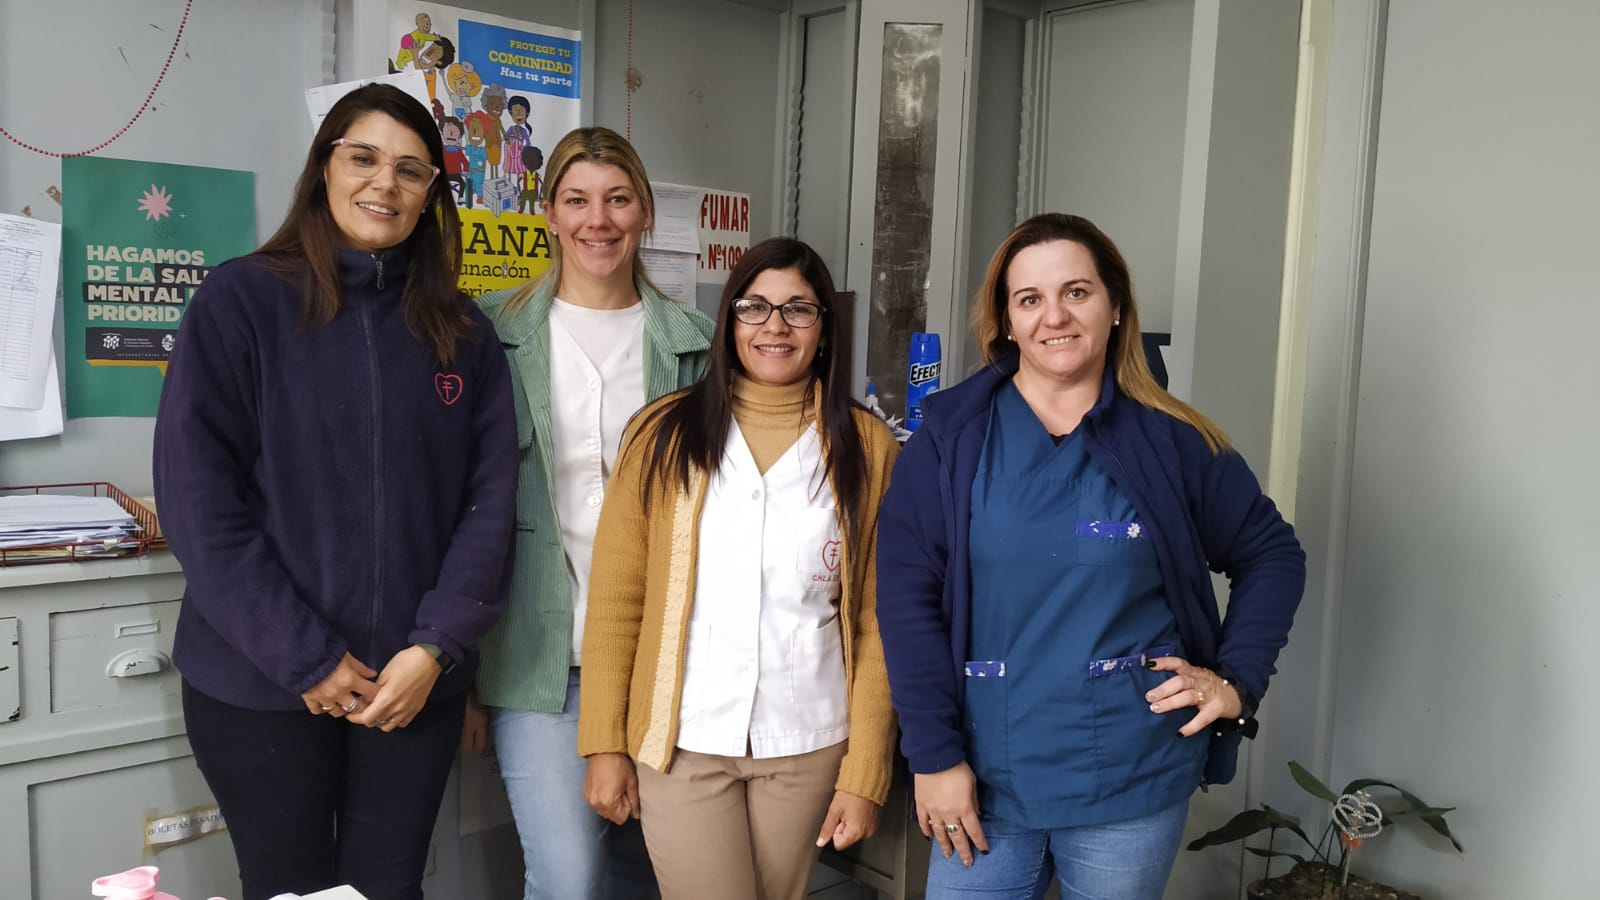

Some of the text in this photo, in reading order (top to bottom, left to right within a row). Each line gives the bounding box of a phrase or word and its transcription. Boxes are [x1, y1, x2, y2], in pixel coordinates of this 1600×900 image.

[510, 40, 571, 57] PROTEGE TU
[488, 50, 573, 74] COMUNIDAD
[500, 66, 572, 87] Haz tu parte
[701, 193, 749, 232] FUMAR
[460, 221, 552, 258] ANA
[87, 245, 204, 266] HAGAMOS
[87, 265, 208, 285] DE LA SAL
[87, 285, 184, 303] MENTAL
[87, 305, 180, 322] PRIORID
[148, 823, 189, 836] BOLETAS
